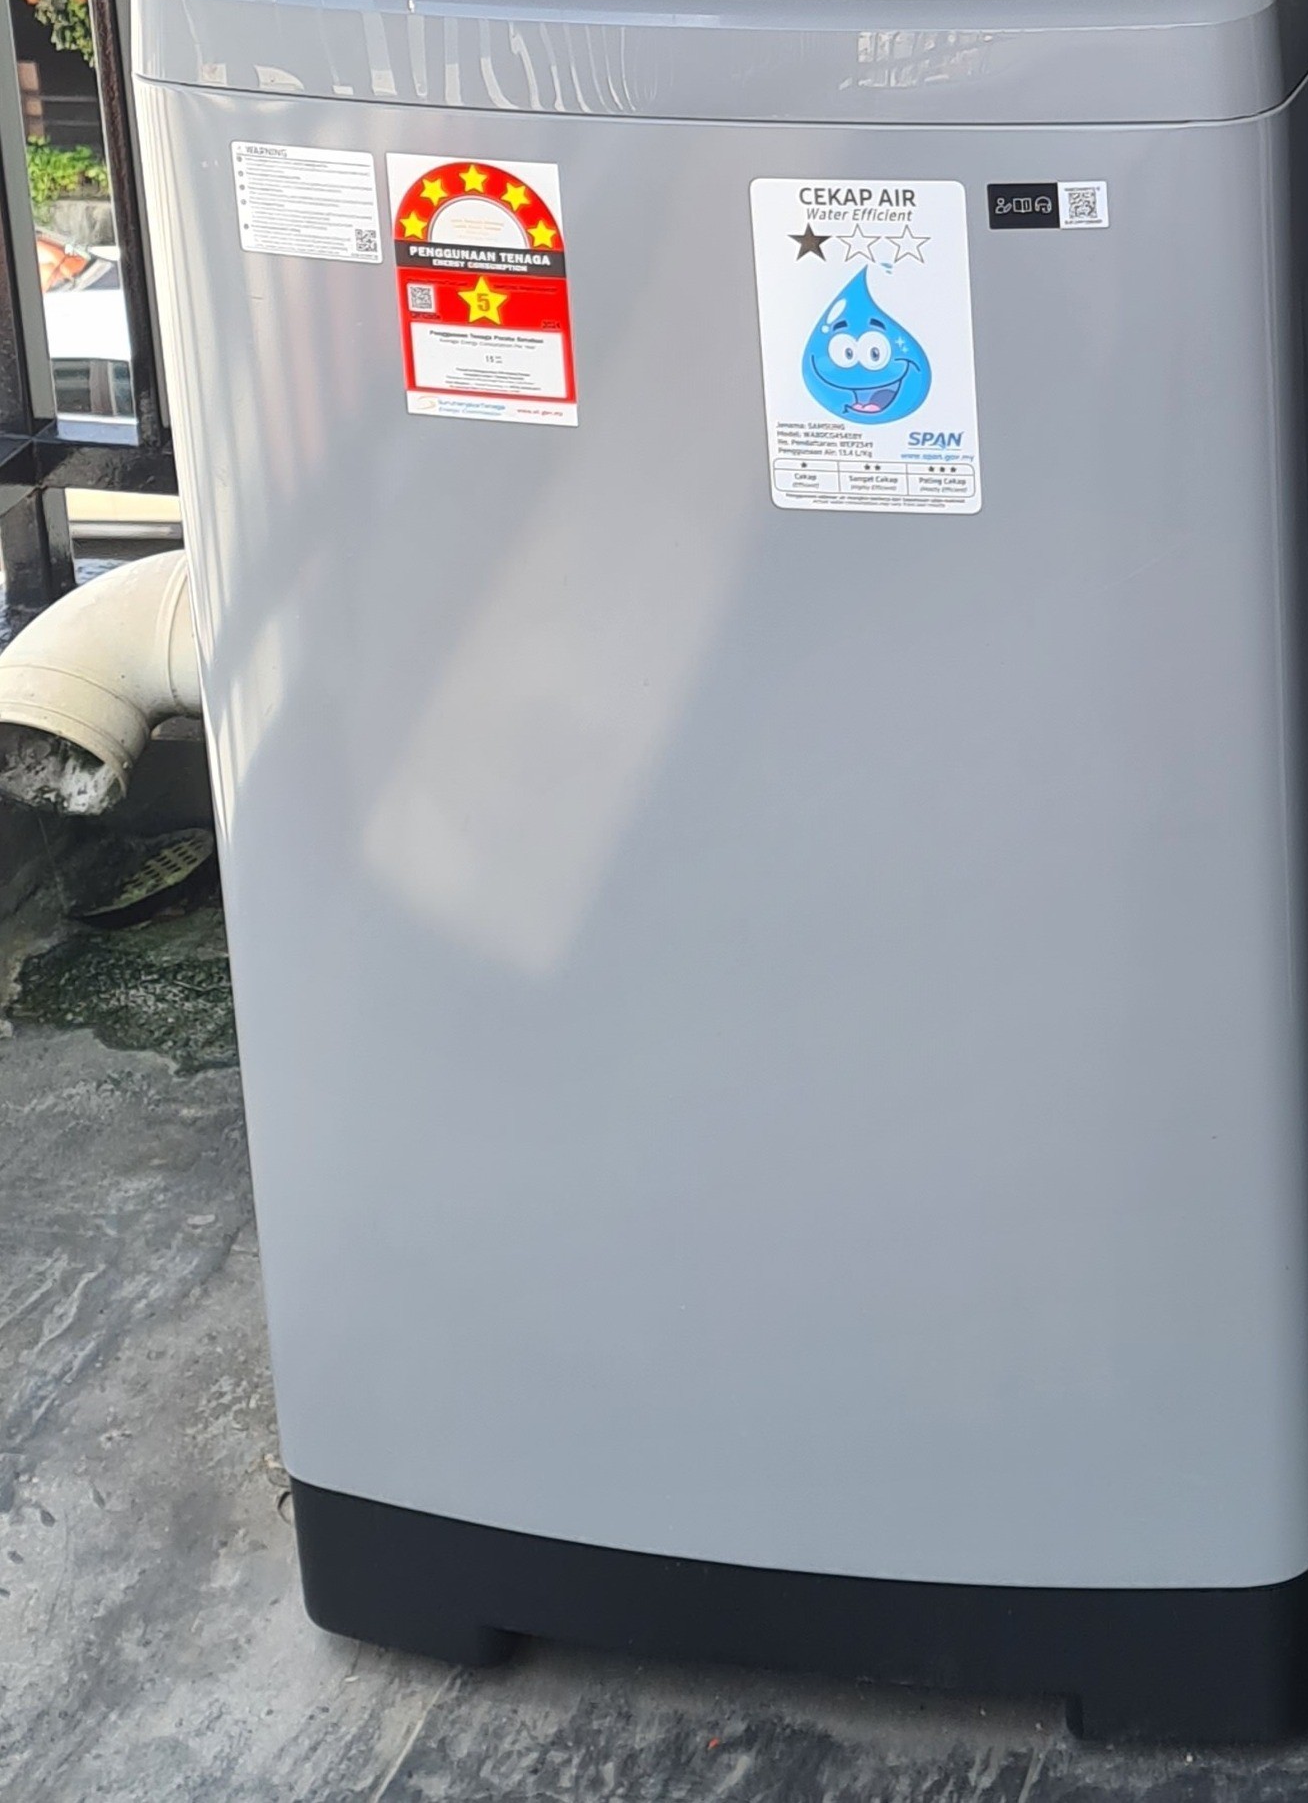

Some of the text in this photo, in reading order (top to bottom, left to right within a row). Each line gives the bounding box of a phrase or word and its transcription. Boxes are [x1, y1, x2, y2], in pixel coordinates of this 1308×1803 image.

[245, 145, 287, 158] WARNING
[799, 187, 917, 207] CEKAP AIR
[806, 207, 913, 222] Water Efficient
[410, 246, 551, 266] PENGGUNAAN TENAGA
[477, 293, 490, 312] 5
[808, 423, 845, 431] SAMSUNG
[908, 431, 965, 447] SPAN
[901, 453, 975, 462] www.span.gov.my
